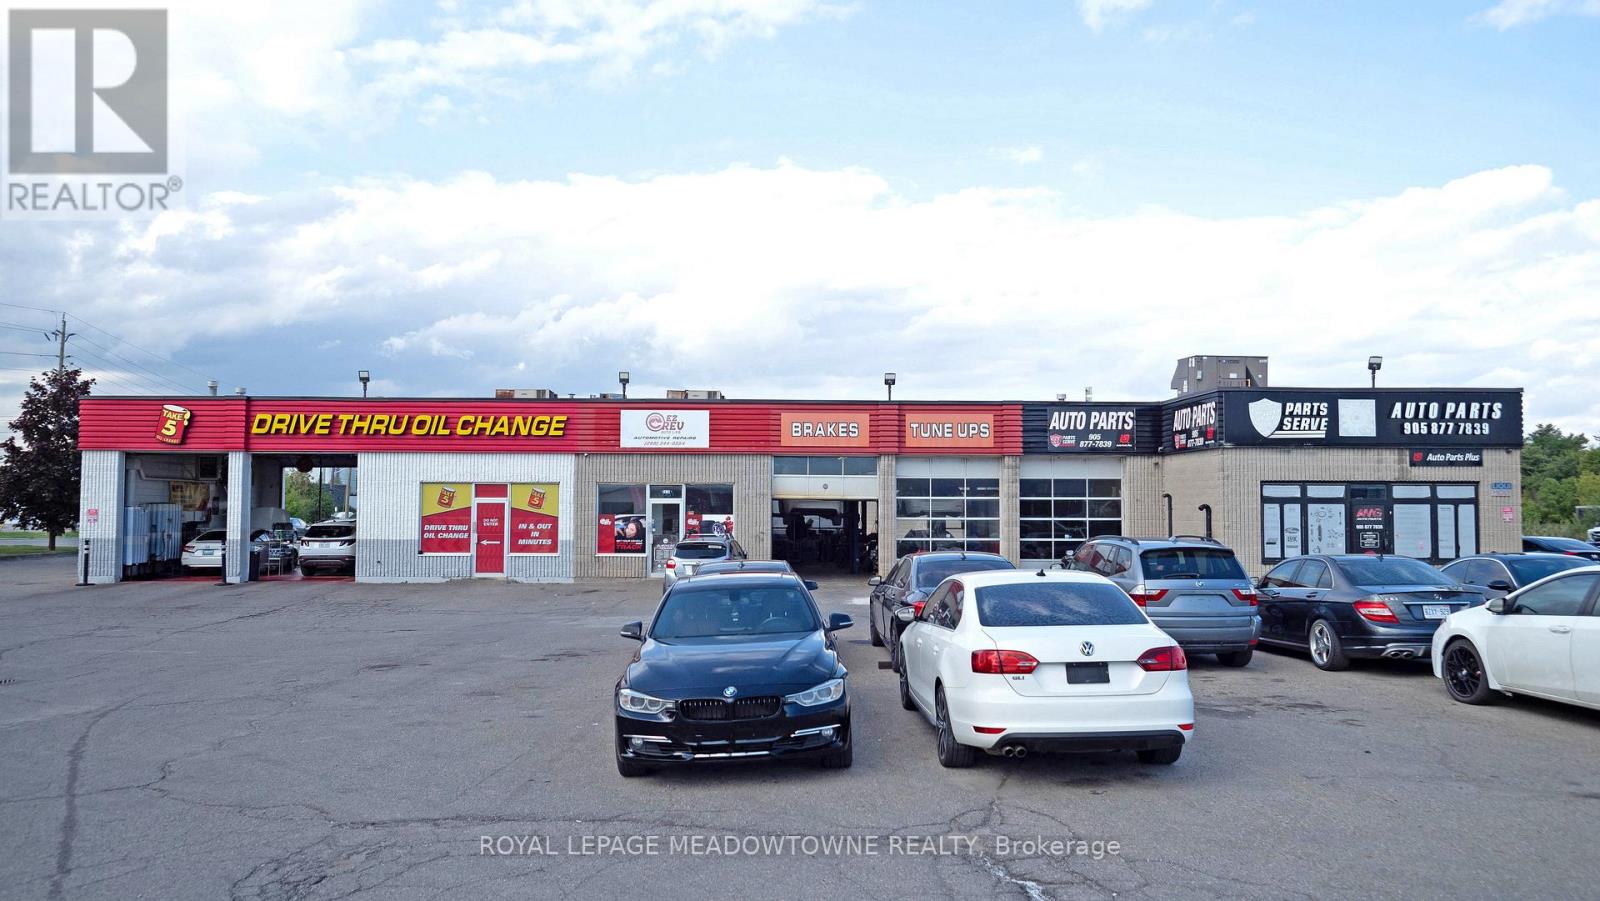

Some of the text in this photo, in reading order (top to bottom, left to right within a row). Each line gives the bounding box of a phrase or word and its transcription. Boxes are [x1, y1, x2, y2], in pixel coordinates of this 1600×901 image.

[163, 410, 183, 420] TAKE
[1285, 402, 1328, 415] PARTS
[1391, 401, 1502, 419] AUTO PARTS
[1050, 411, 1134, 431] AUTO PARTS
[1173, 401, 1216, 431] AUTO PARTS
[161, 419, 177, 436] 5
[251, 413, 567, 437] DRIVE THRU OIL CHANGE
[661, 421, 685, 431] REV
[791, 422, 859, 438] BRAKES
[910, 422, 990, 439] TUNE UPS
[1283, 417, 1328, 431] SERVE
[1403, 422, 1490, 435] 905 877 7839
[1079, 440, 1112, 448] 877-7839
[1426, 453, 1480, 461] Auto Parts Plus
[440, 495, 450, 504] 5
[531, 496, 541, 505] 5
